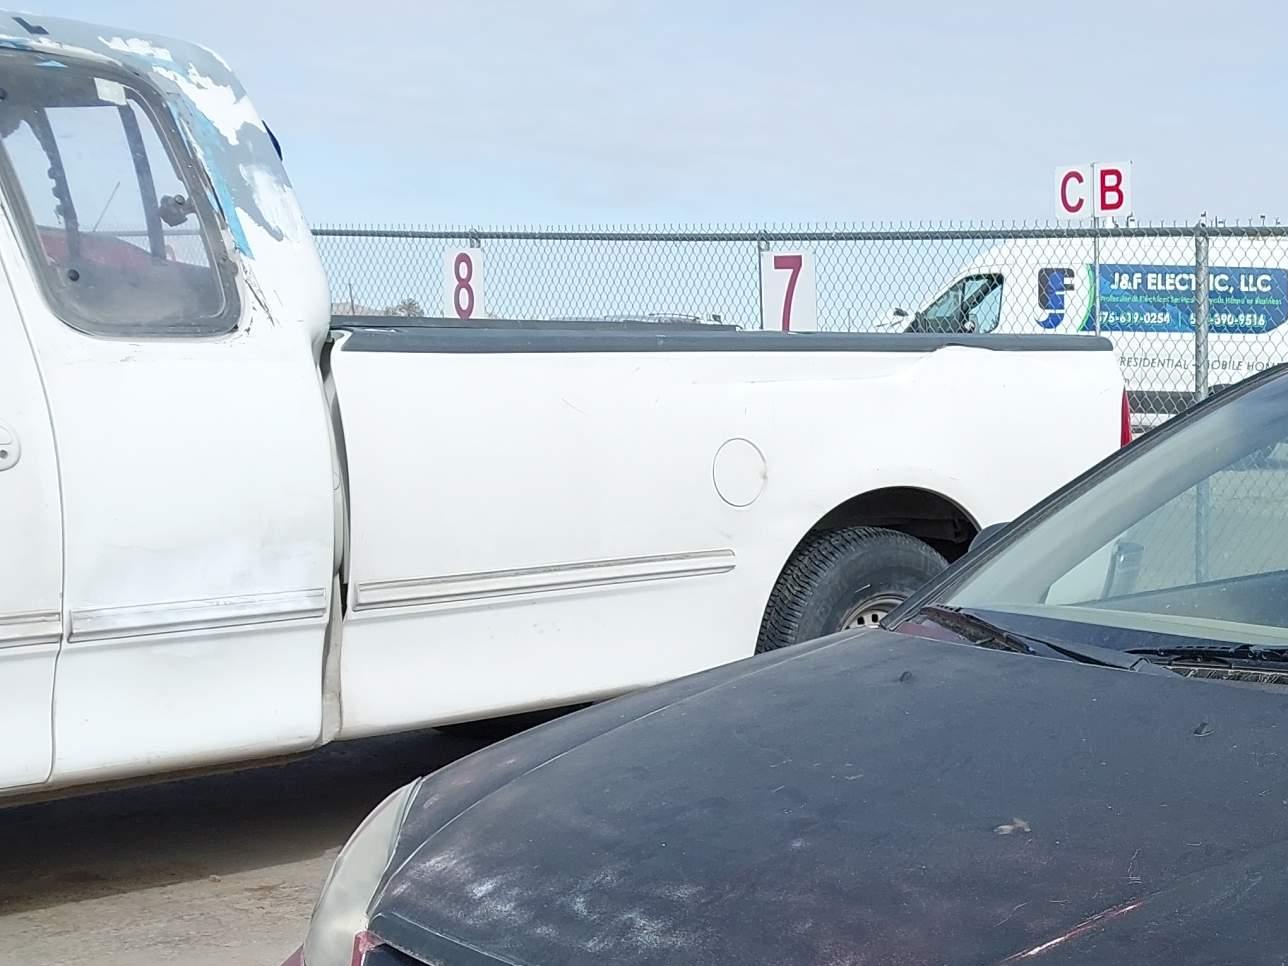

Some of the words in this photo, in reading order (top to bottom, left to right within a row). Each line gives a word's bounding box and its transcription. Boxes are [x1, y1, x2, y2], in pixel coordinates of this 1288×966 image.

[1060, 170, 1084, 213] C
[1099, 168, 1123, 210] B
[454, 252, 474, 320] 8
[774, 255, 802, 332] 7
[1110, 272, 1142, 290] J&F
[1147, 273, 1234, 293] ELECTIC,
[1240, 274, 1272, 292] LLC
[1120, 356, 1189, 370] RESIDENTIAL
[1206, 360, 1242, 371] OBILE
[1246, 361, 1280, 372] HOM
